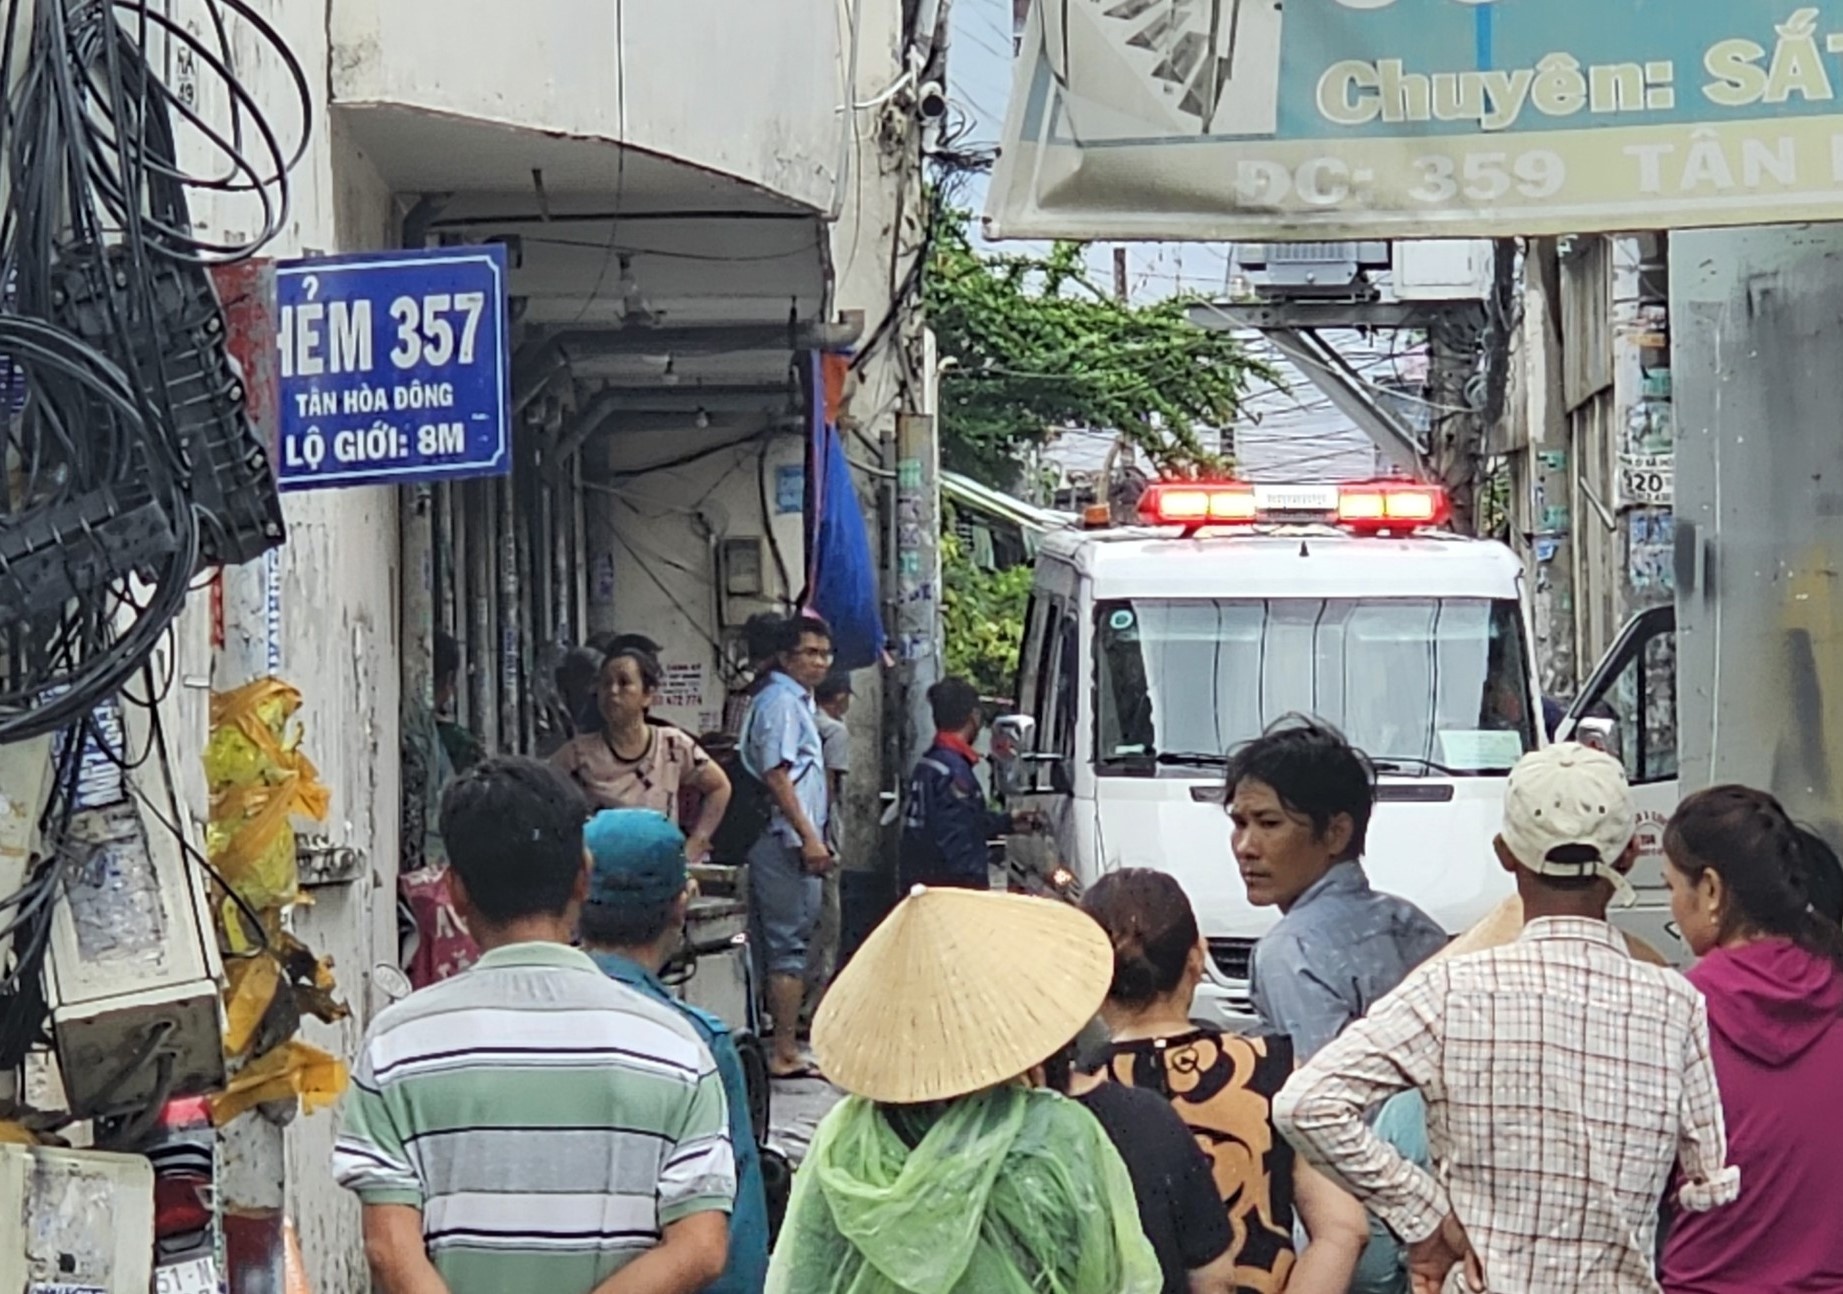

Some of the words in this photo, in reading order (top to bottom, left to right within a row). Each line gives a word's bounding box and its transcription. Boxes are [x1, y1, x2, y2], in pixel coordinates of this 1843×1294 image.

[1316, 52, 1675, 131] Chuyên:
[1409, 150, 1566, 200] 359
[1623, 128, 1799, 193] TÂN
[389, 291, 485, 369] 357
[295, 385, 338, 418] TÂN
[343, 382, 389, 414] HÒA
[394, 379, 454, 410] ĐÔNG
[285, 425, 326, 471] LỘ
[333, 419, 409, 462] GIỚI:
[417, 422, 465, 456] 8M
